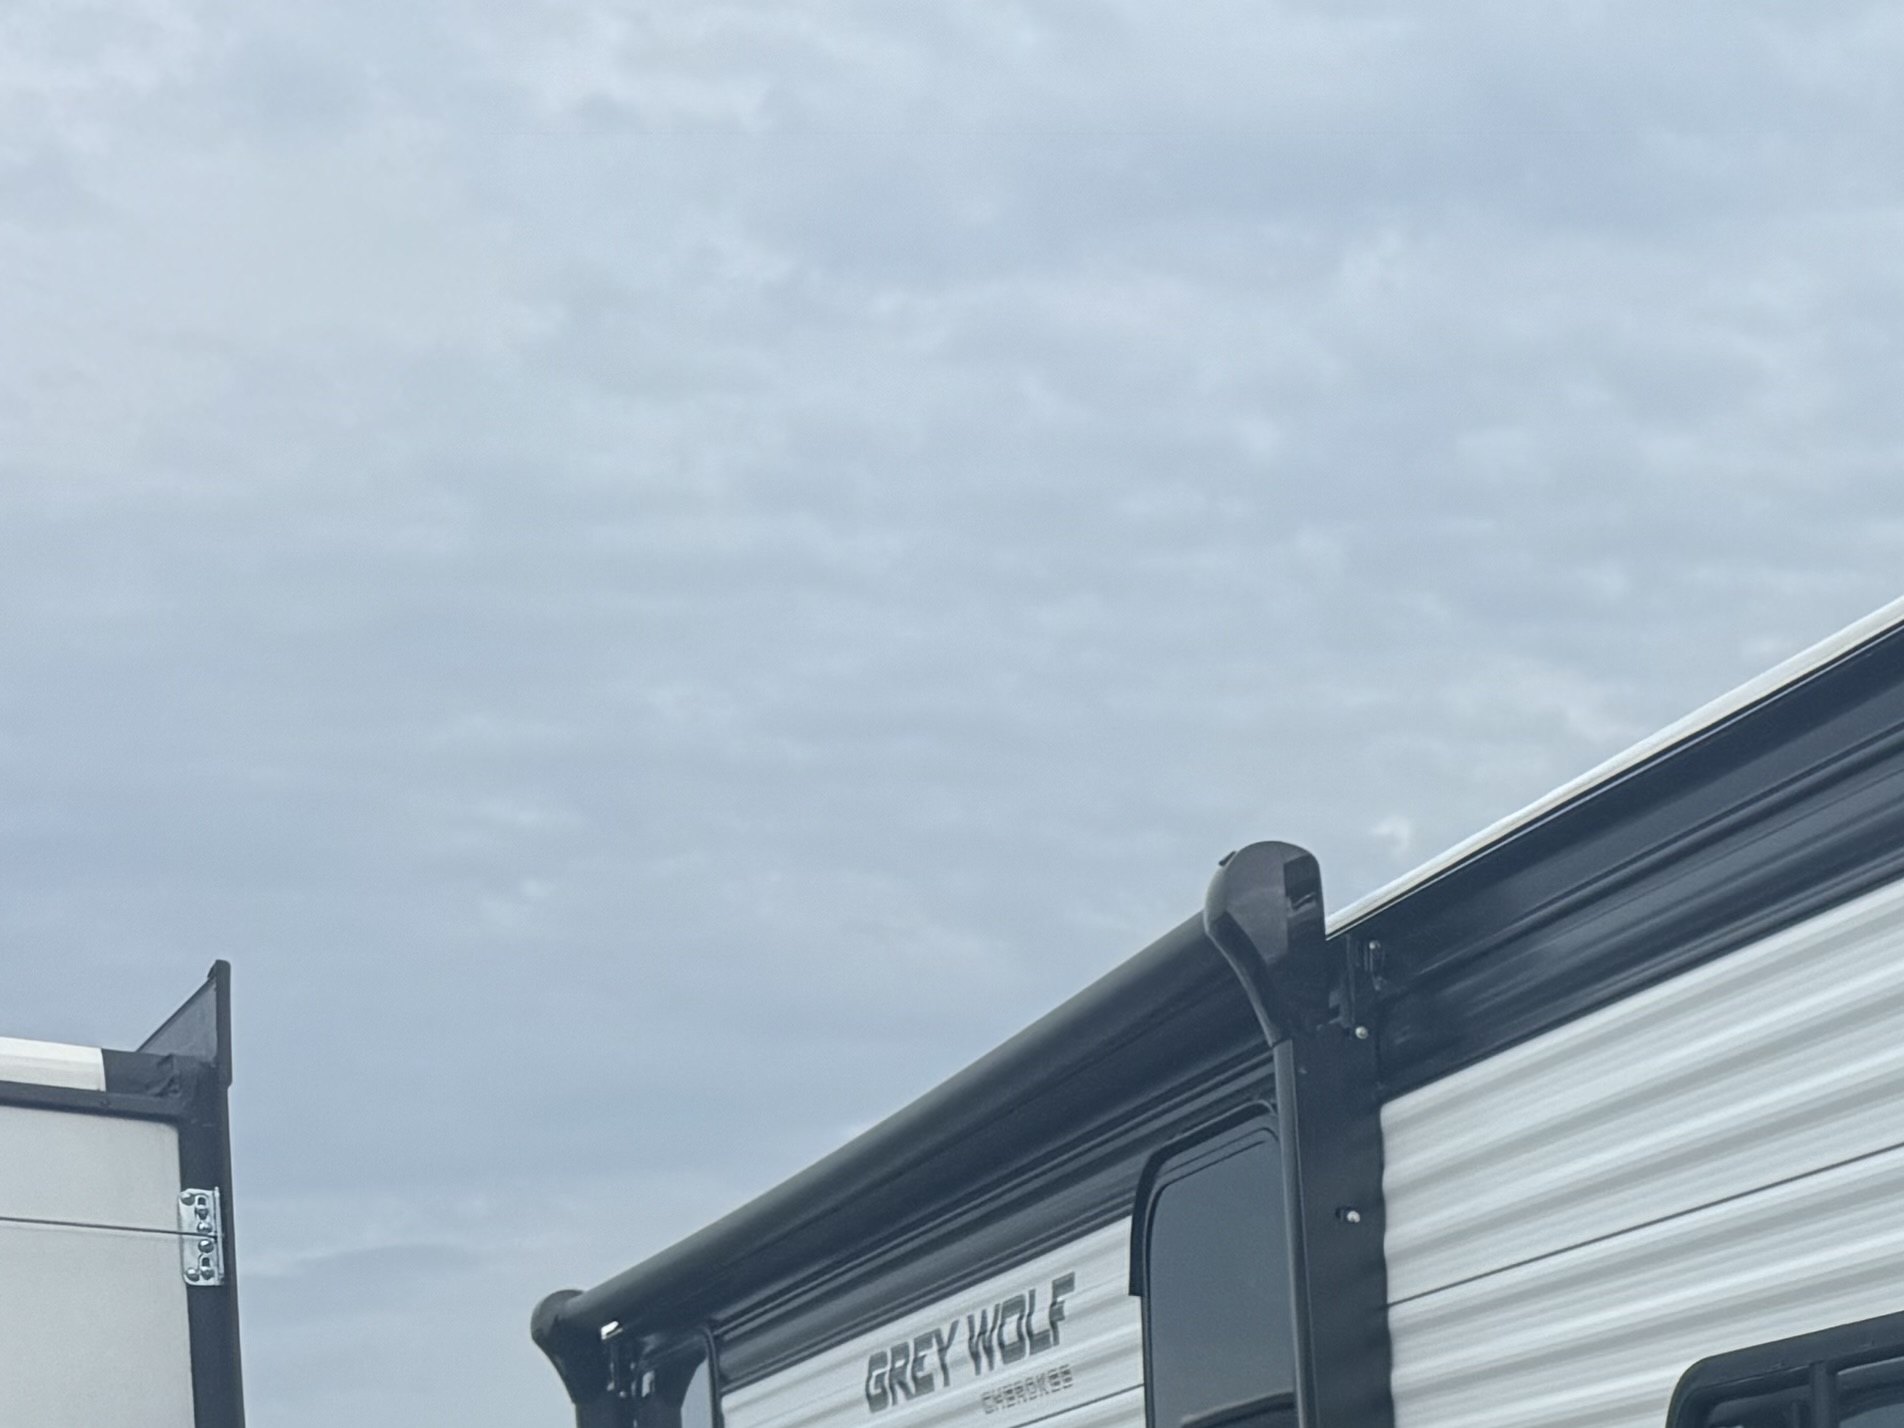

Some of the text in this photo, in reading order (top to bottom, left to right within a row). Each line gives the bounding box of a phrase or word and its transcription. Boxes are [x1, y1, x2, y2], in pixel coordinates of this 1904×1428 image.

[866, 1271, 1076, 1414] GREY WOLF
[981, 1363, 1073, 1415] CHEROKEE
